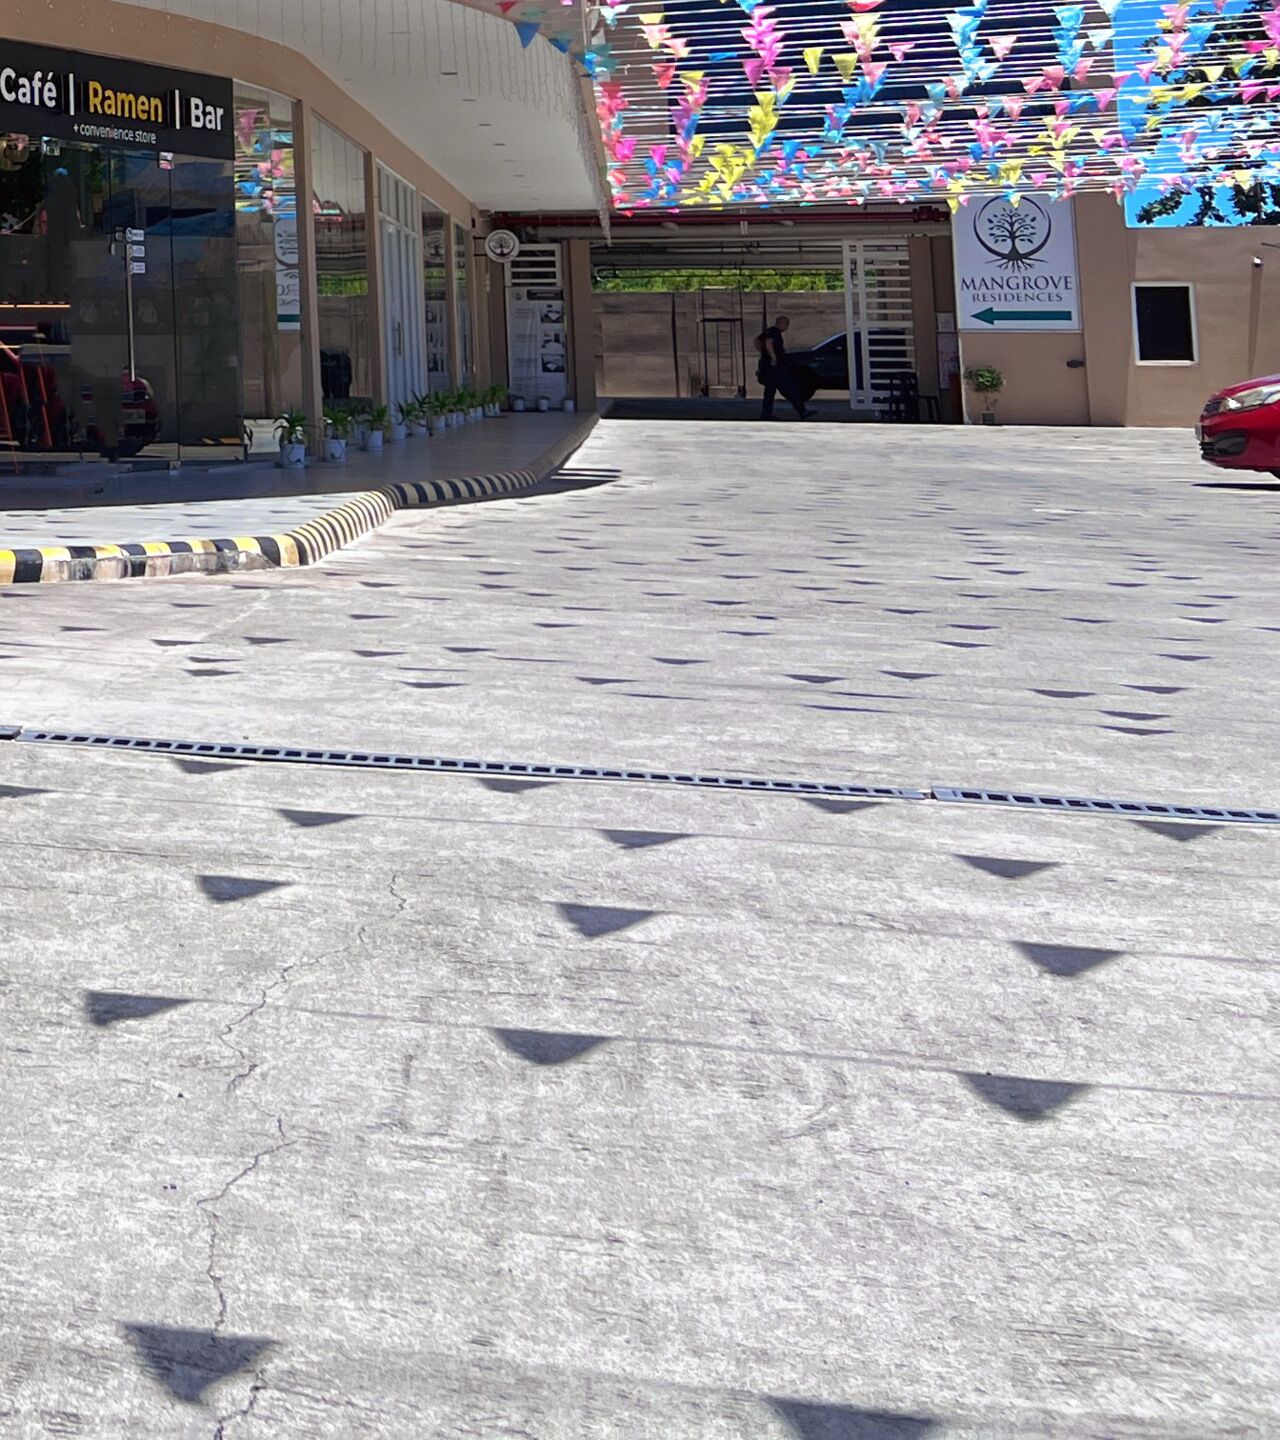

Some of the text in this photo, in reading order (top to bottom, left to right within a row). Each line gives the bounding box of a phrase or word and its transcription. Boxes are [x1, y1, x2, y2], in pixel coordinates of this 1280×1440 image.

[0, 67, 57, 108] Café
[88, 80, 163, 123] Ramen
[190, 97, 224, 131] Bar
[79, 122, 134, 142] convenience
[134, 127, 157, 145] store
[960, 275, 1073, 291] MANGROVE
[972, 292, 1063, 302] RESIDENCES
